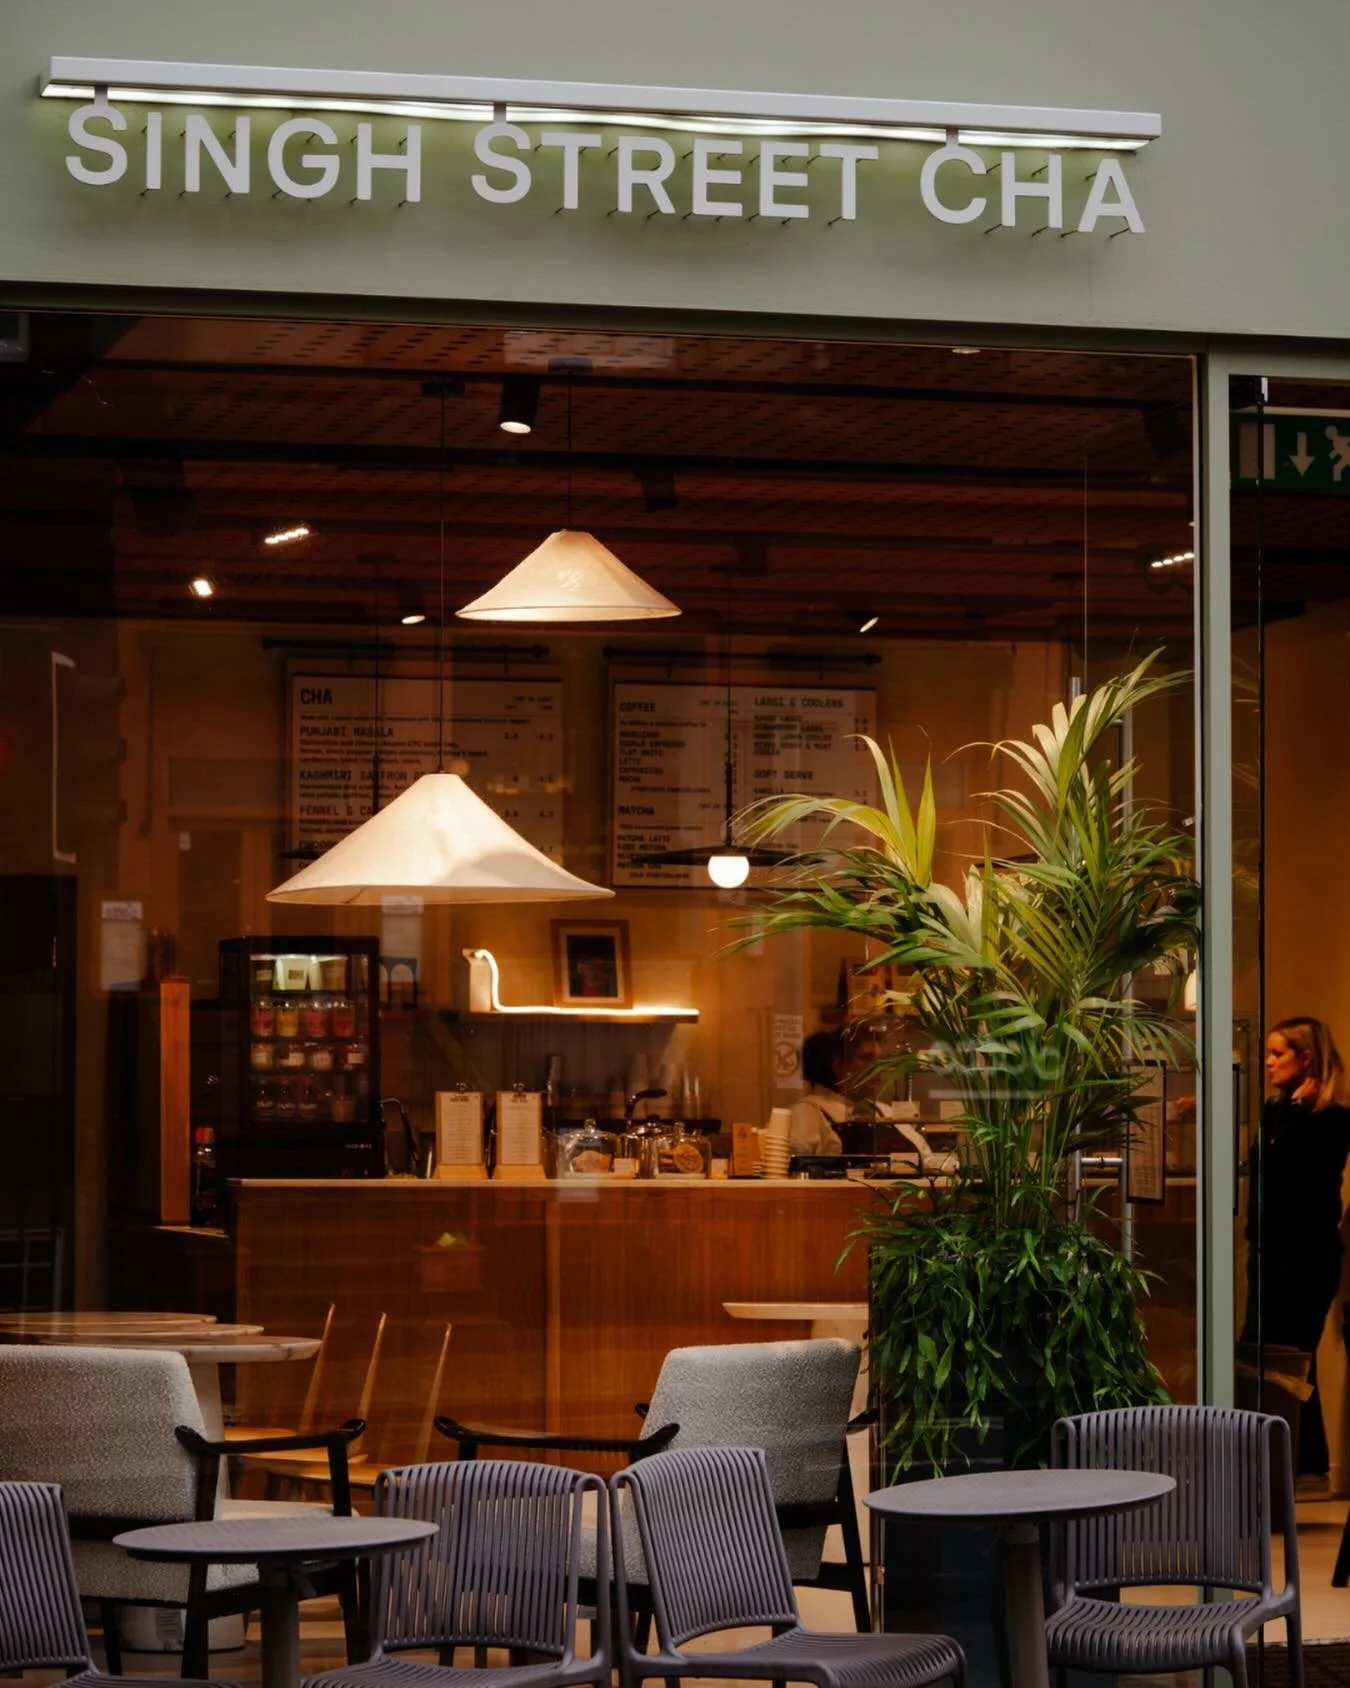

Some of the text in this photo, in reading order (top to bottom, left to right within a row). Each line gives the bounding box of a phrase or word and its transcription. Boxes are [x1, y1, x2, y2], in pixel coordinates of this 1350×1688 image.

[66, 103, 1145, 233] SINGH STREET CHA
[300, 688, 333, 704] CHA
[619, 702, 656, 712] COFFEE
[801, 699, 843, 708] COOLERS
[300, 726, 394, 737] PUNJABI MASALA
[299, 770, 351, 781] KASHMIRI
[360, 771, 407, 782] SAFRON
[300, 805, 340, 816] FENNEL
[618, 805, 654, 816] MATCHA
